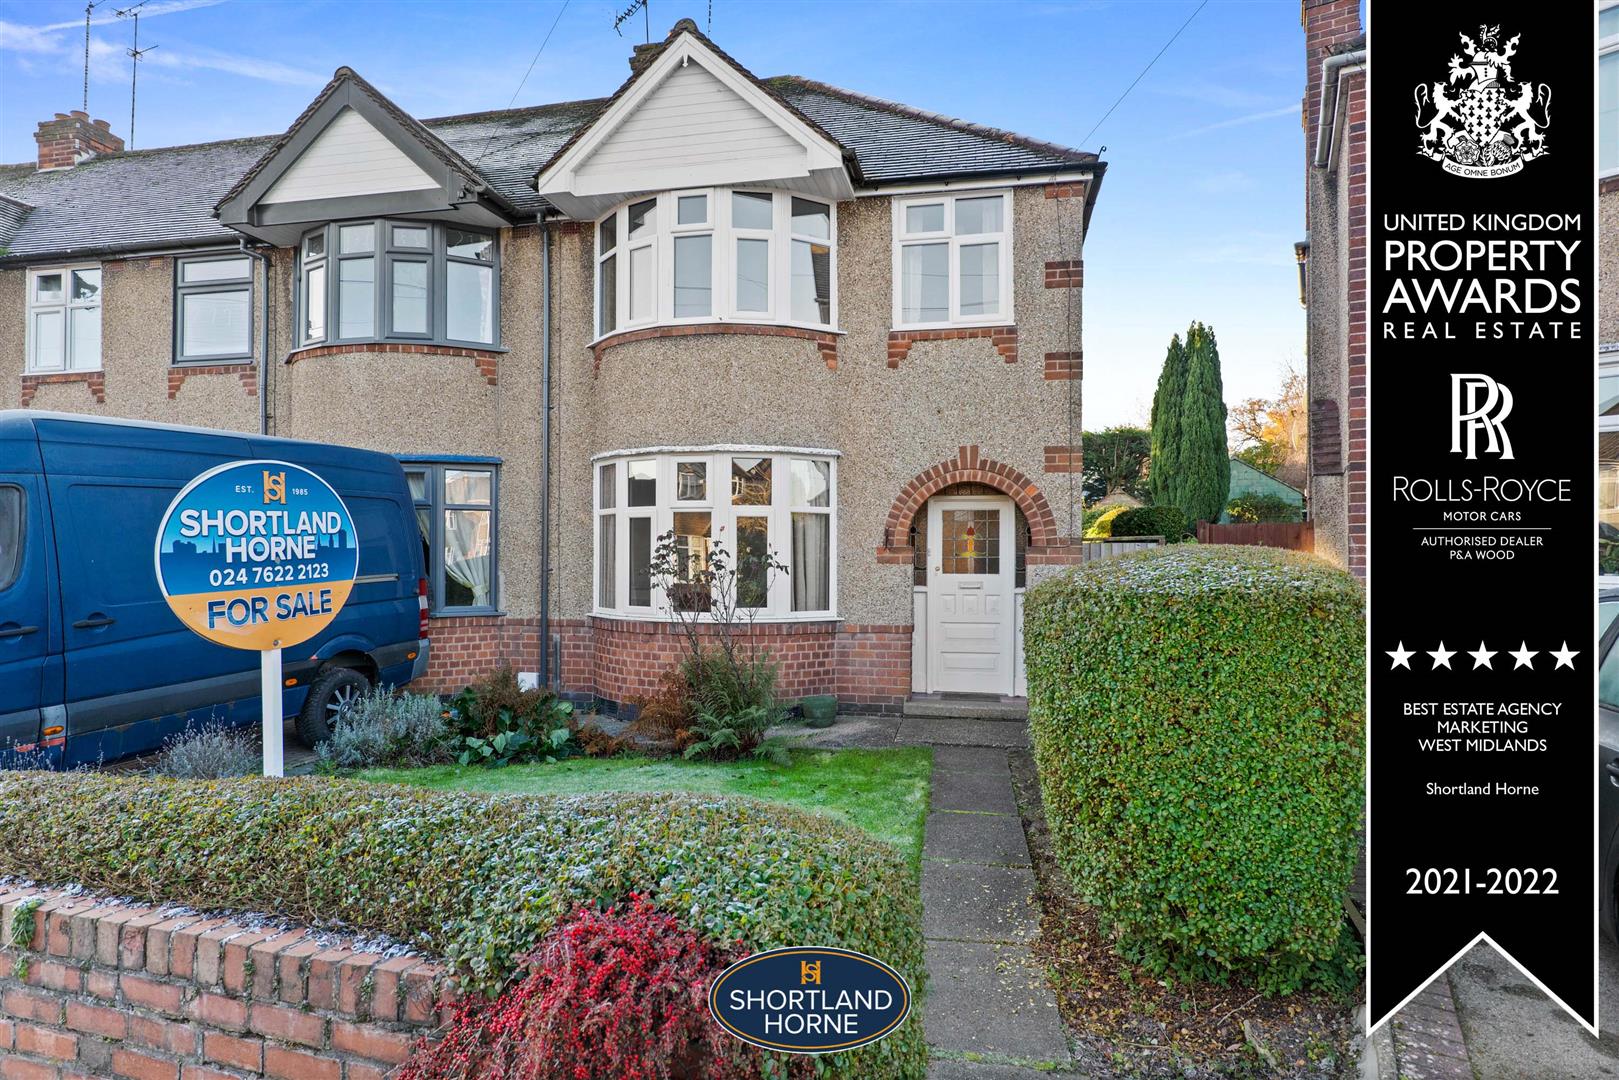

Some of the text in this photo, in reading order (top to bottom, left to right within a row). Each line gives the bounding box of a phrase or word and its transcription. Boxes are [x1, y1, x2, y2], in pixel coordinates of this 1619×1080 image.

[235, 485, 255, 494] EST.
[292, 487, 309, 496] 1985
[179, 509, 343, 537] SHORTLAND
[225, 535, 317, 564] HORNE
[209, 562, 330, 587] 024 7622 2123
[207, 588, 333, 630] FOR SALE
